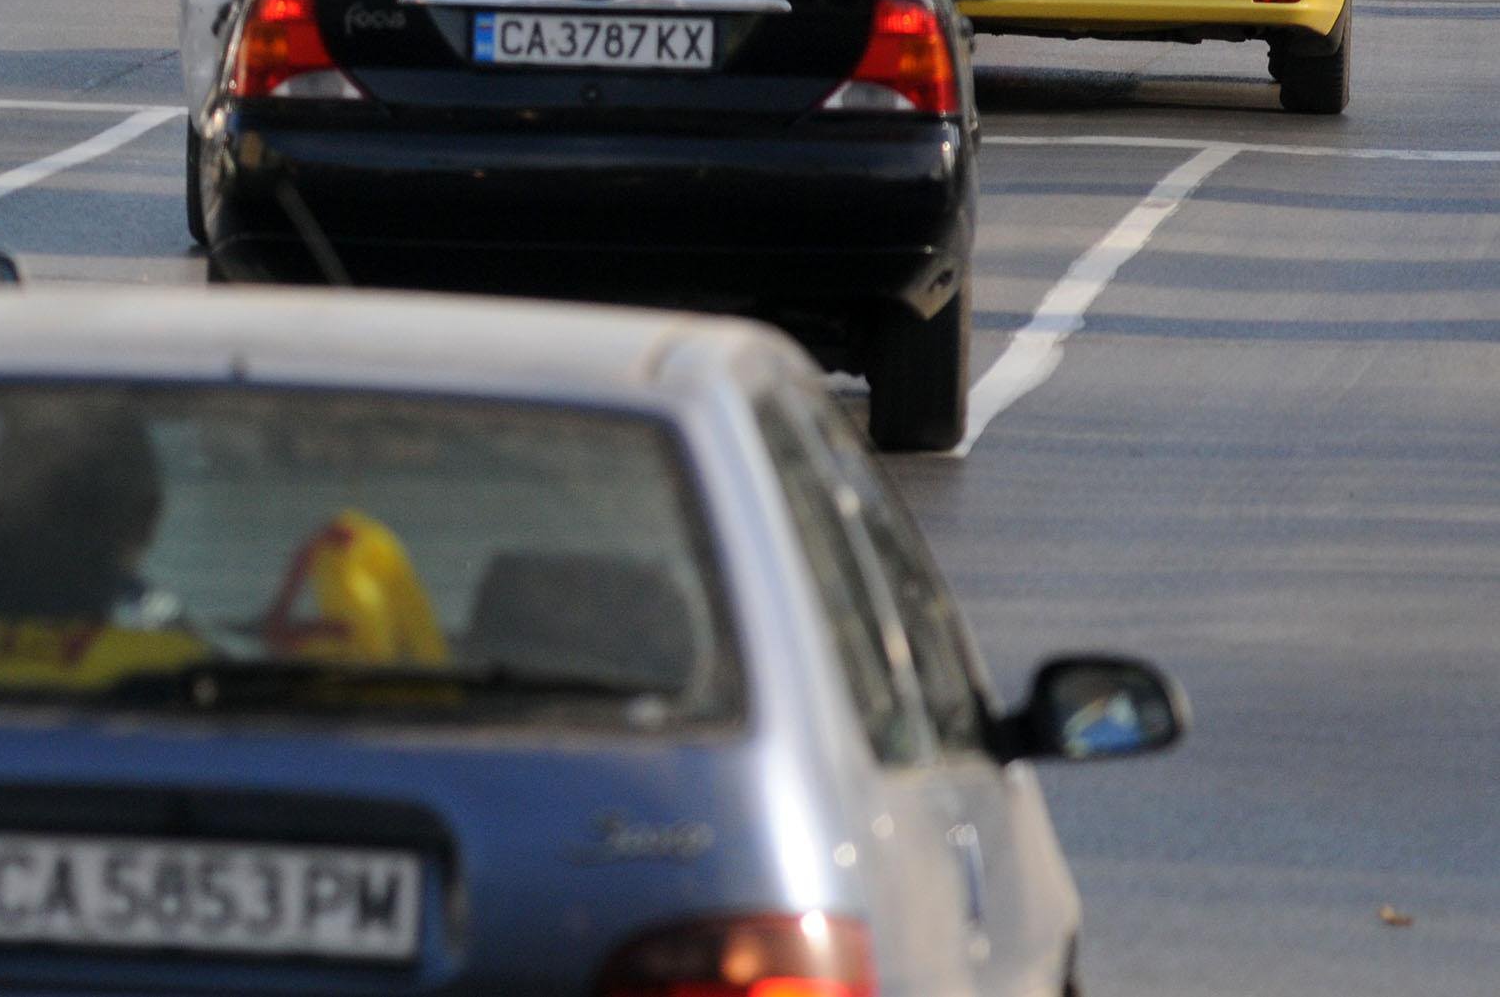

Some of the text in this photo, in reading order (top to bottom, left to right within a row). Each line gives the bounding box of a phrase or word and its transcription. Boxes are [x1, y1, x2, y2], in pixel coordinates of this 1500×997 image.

[500, 19, 705, 61] CA 3787 KX
[101, 856, 286, 937] 5853
